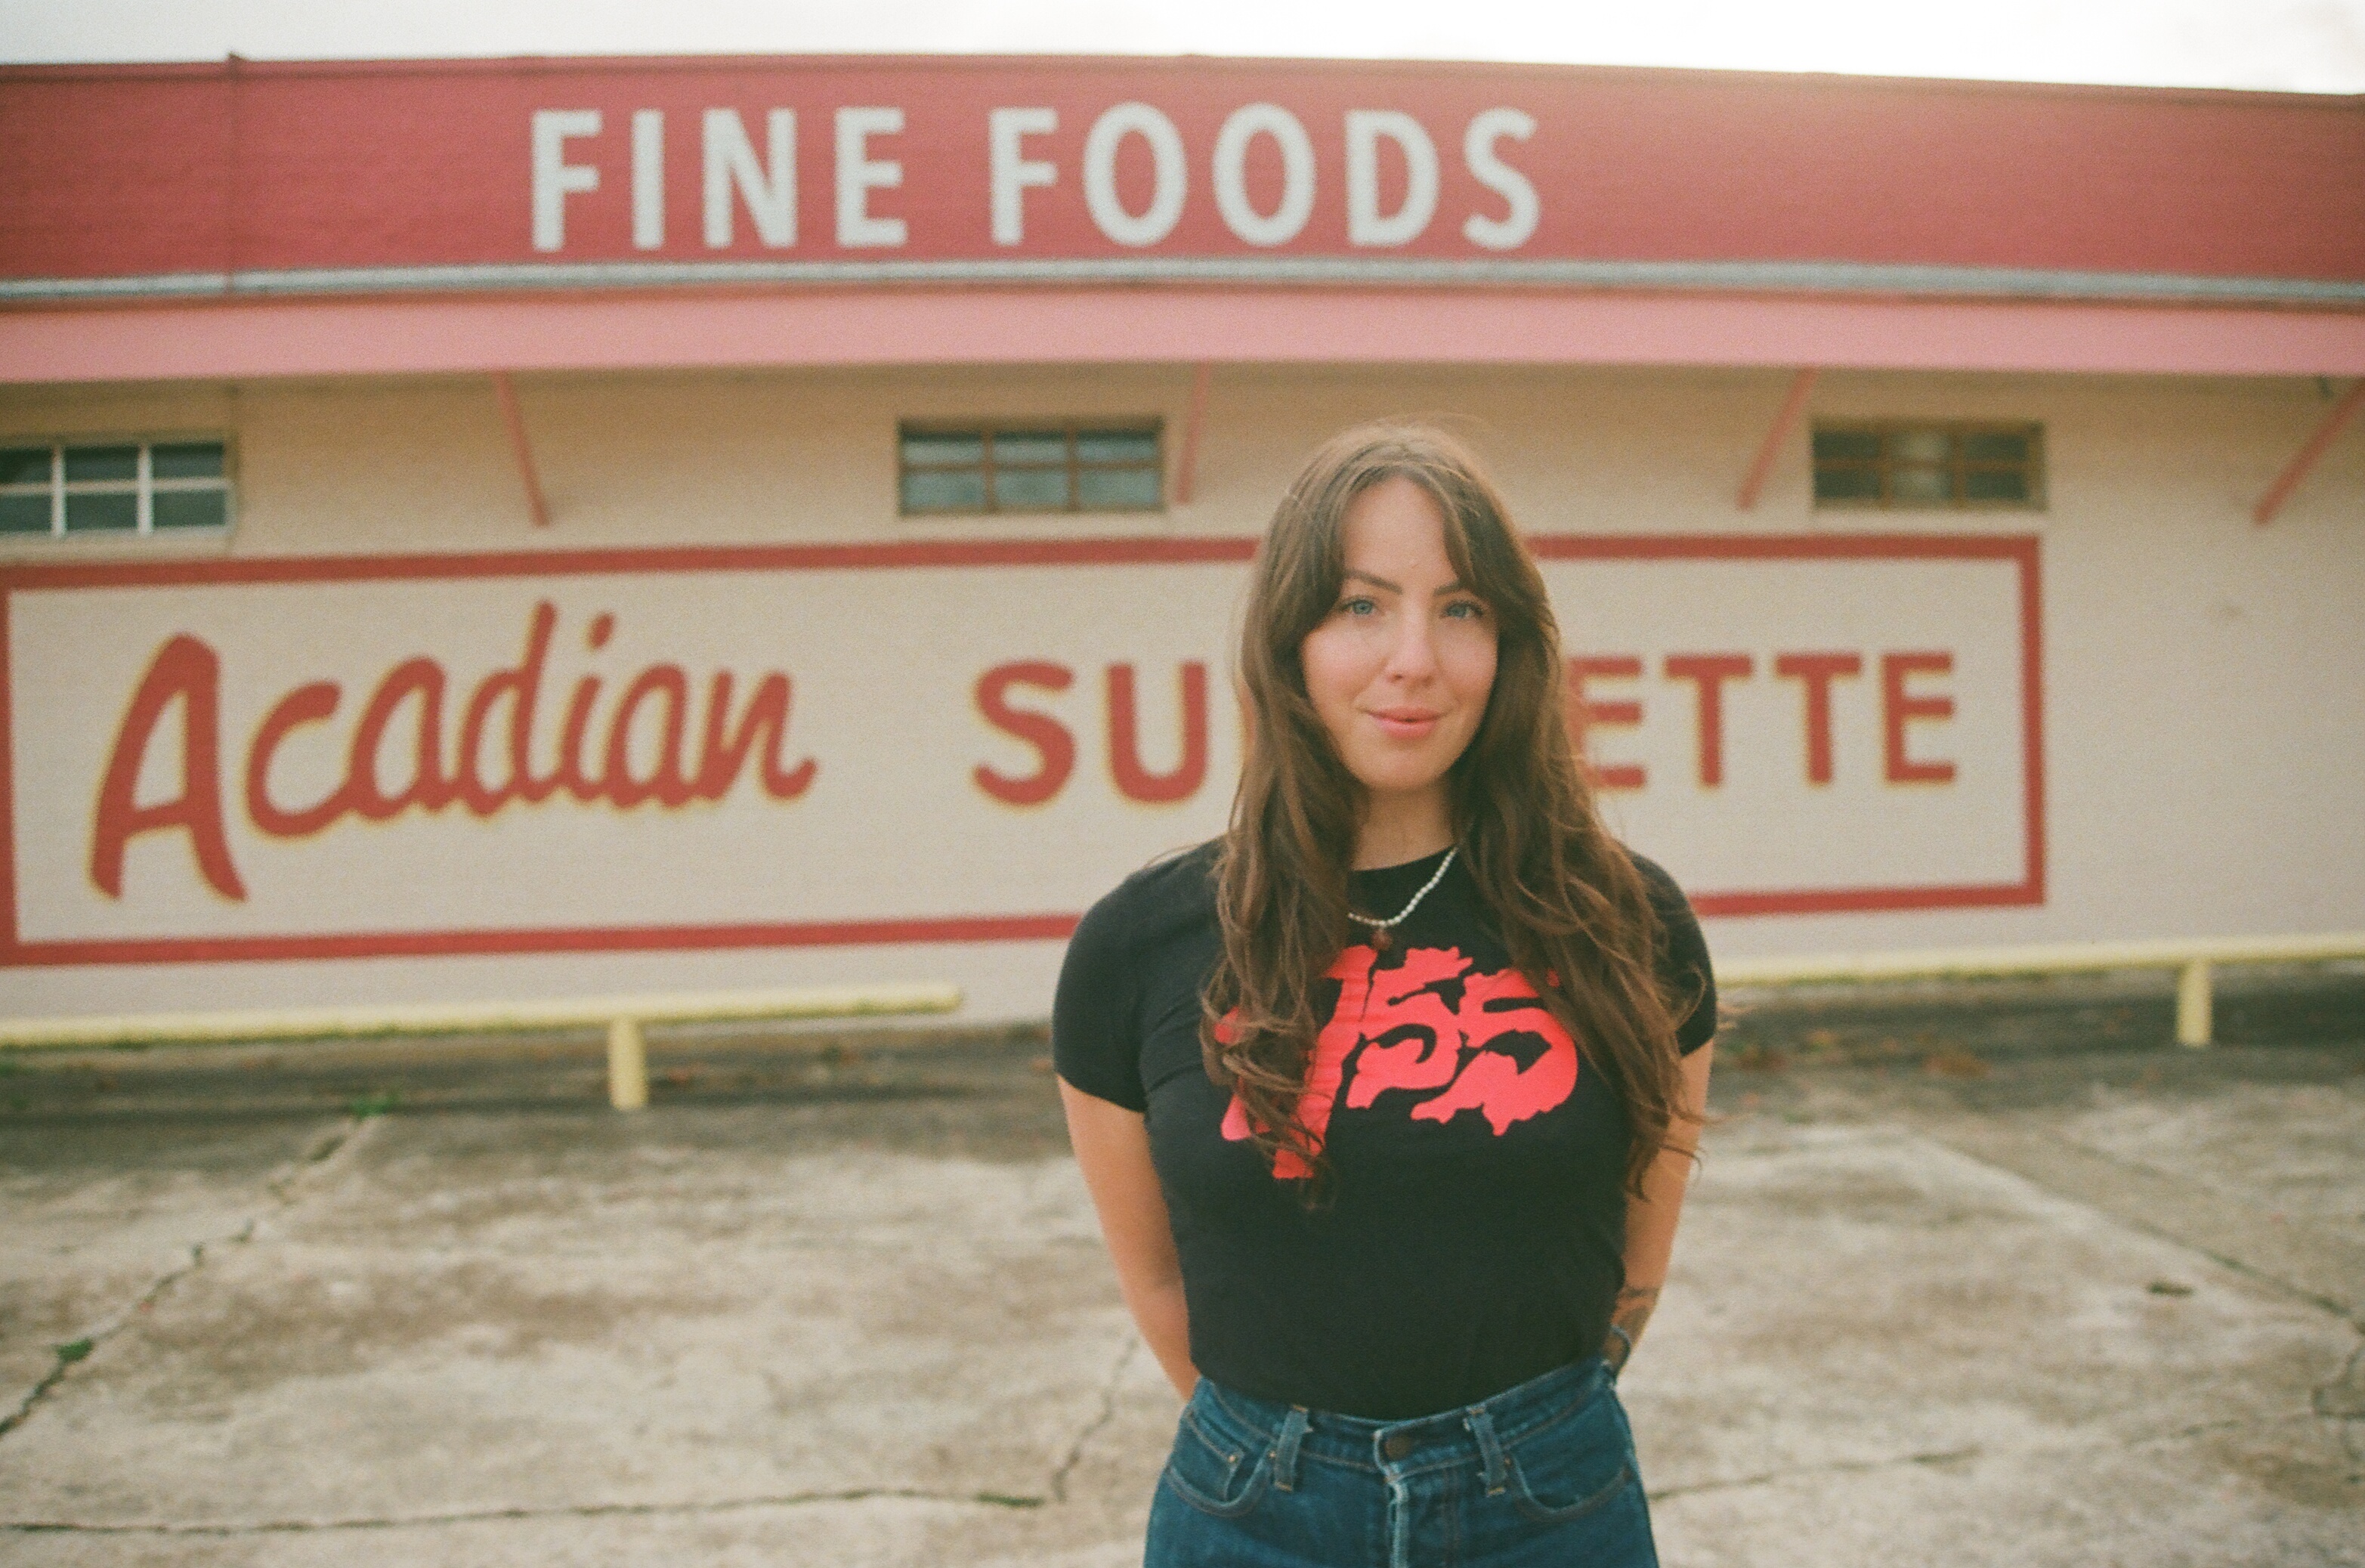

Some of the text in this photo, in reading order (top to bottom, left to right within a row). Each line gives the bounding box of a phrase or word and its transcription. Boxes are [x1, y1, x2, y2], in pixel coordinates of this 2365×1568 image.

[530, 100, 1542, 252] FINE FOODS
[88, 599, 1958, 903] Acadian SUETTE
